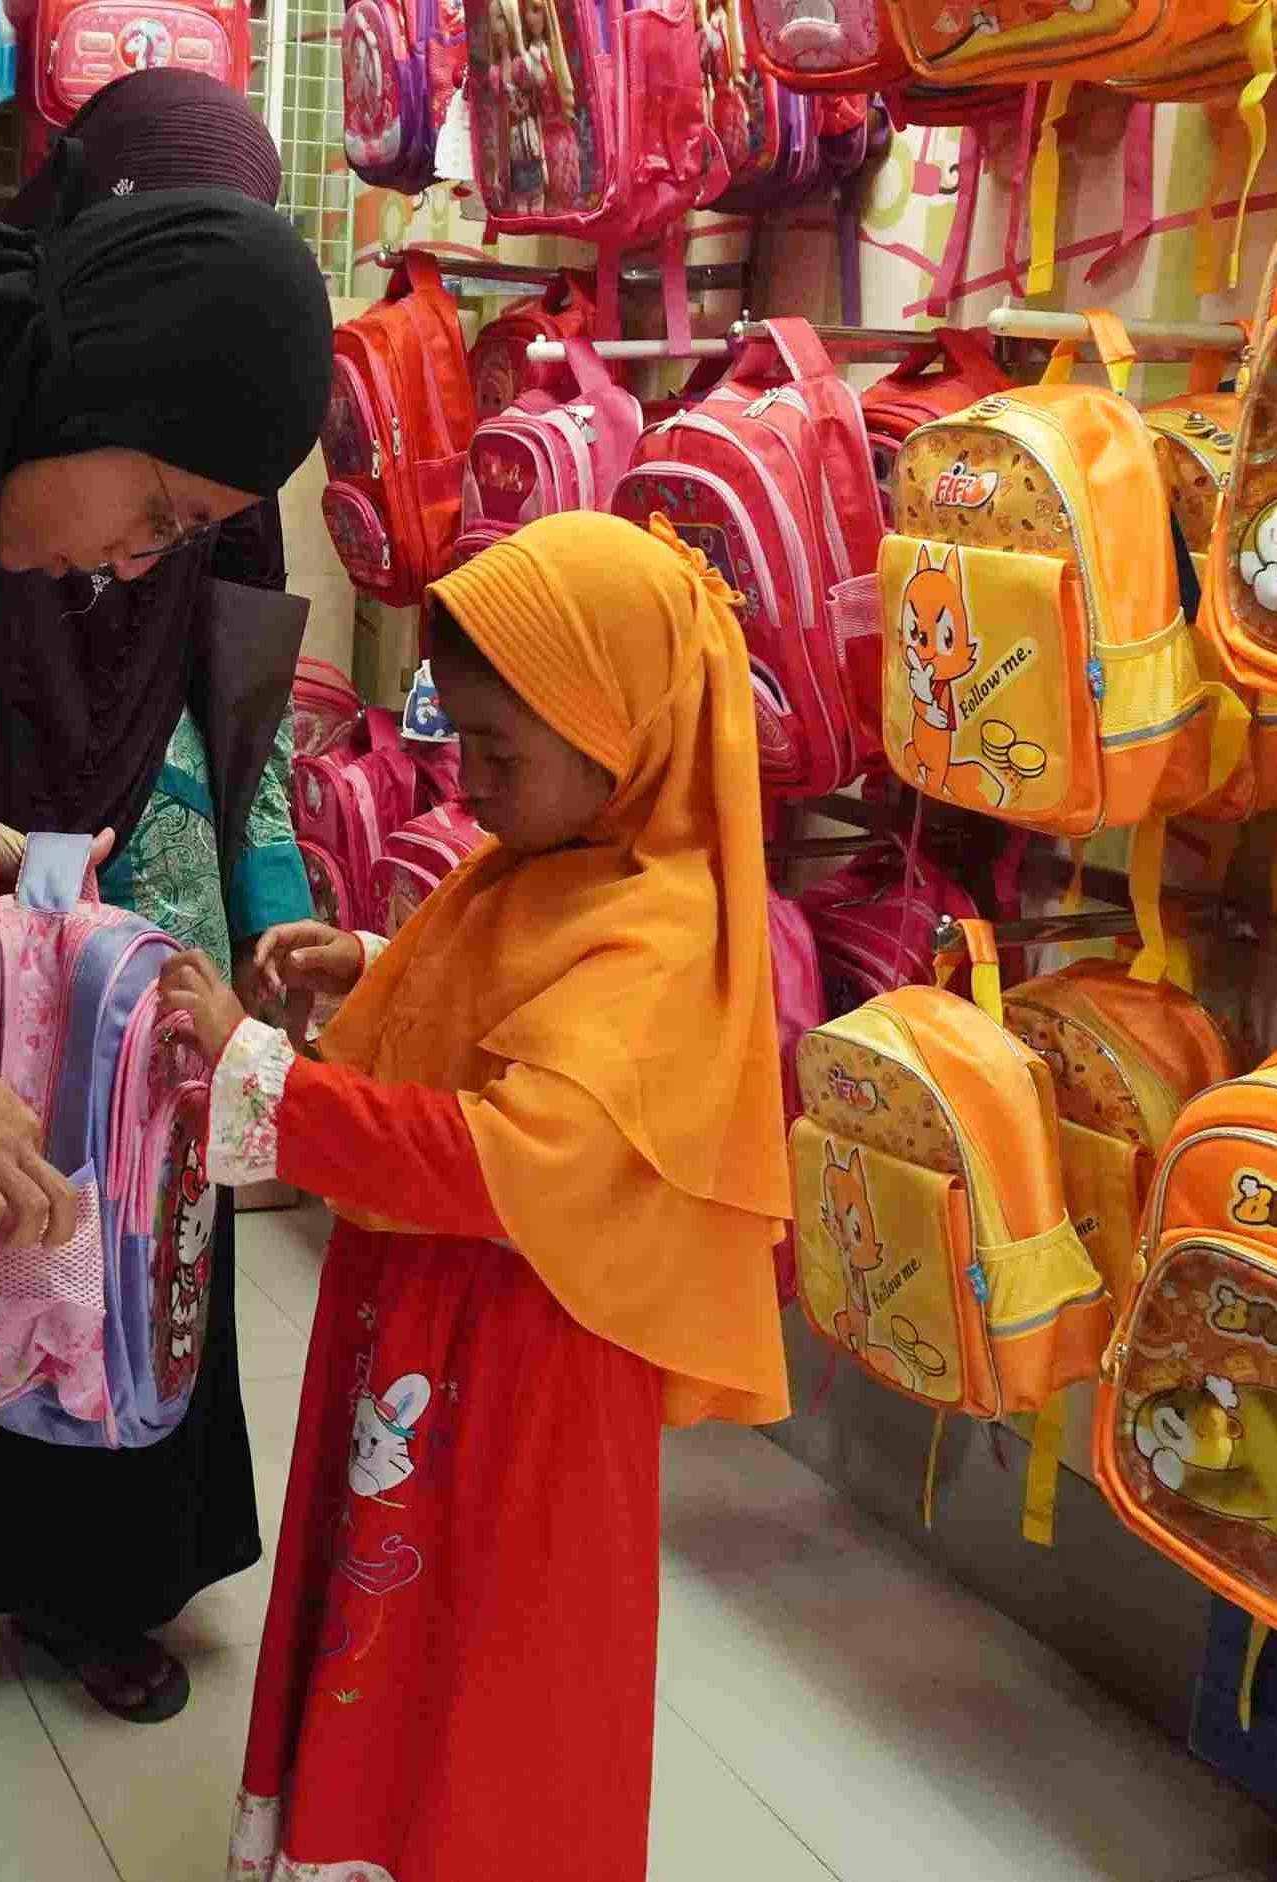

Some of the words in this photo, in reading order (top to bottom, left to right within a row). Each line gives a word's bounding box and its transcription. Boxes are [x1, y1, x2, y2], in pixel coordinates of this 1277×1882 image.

[958, 671, 1001, 720] Follow
[1001, 647, 1033, 677] me.
[870, 1272, 902, 1311] Follow
